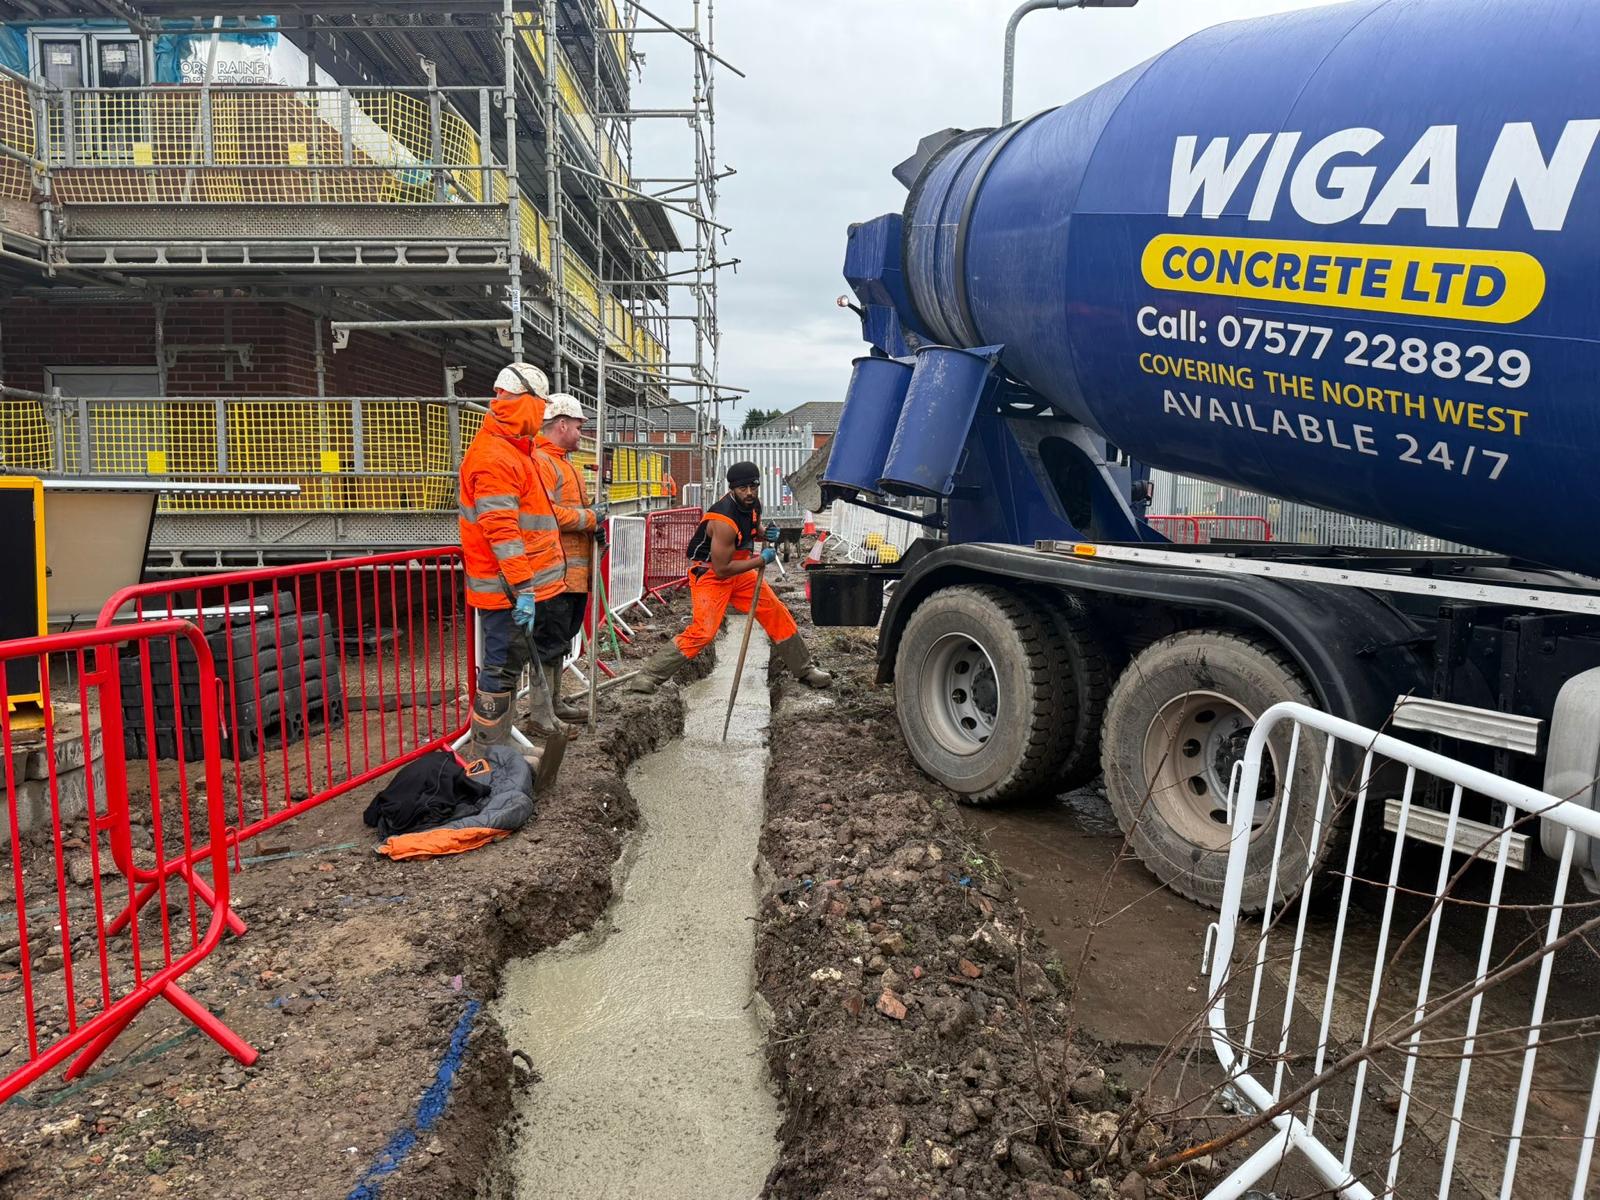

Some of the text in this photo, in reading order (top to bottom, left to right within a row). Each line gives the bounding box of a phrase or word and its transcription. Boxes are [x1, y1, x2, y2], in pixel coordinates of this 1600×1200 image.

[1167, 118, 1600, 231] WIGAN
[1162, 246, 1507, 307] CONCRETE LTD
[1136, 305, 1531, 388] Call: 07577 228829
[1139, 352, 1529, 436] COVERING THE NORTH WEST
[1163, 389, 1509, 480] AVAILABLE 24/7
